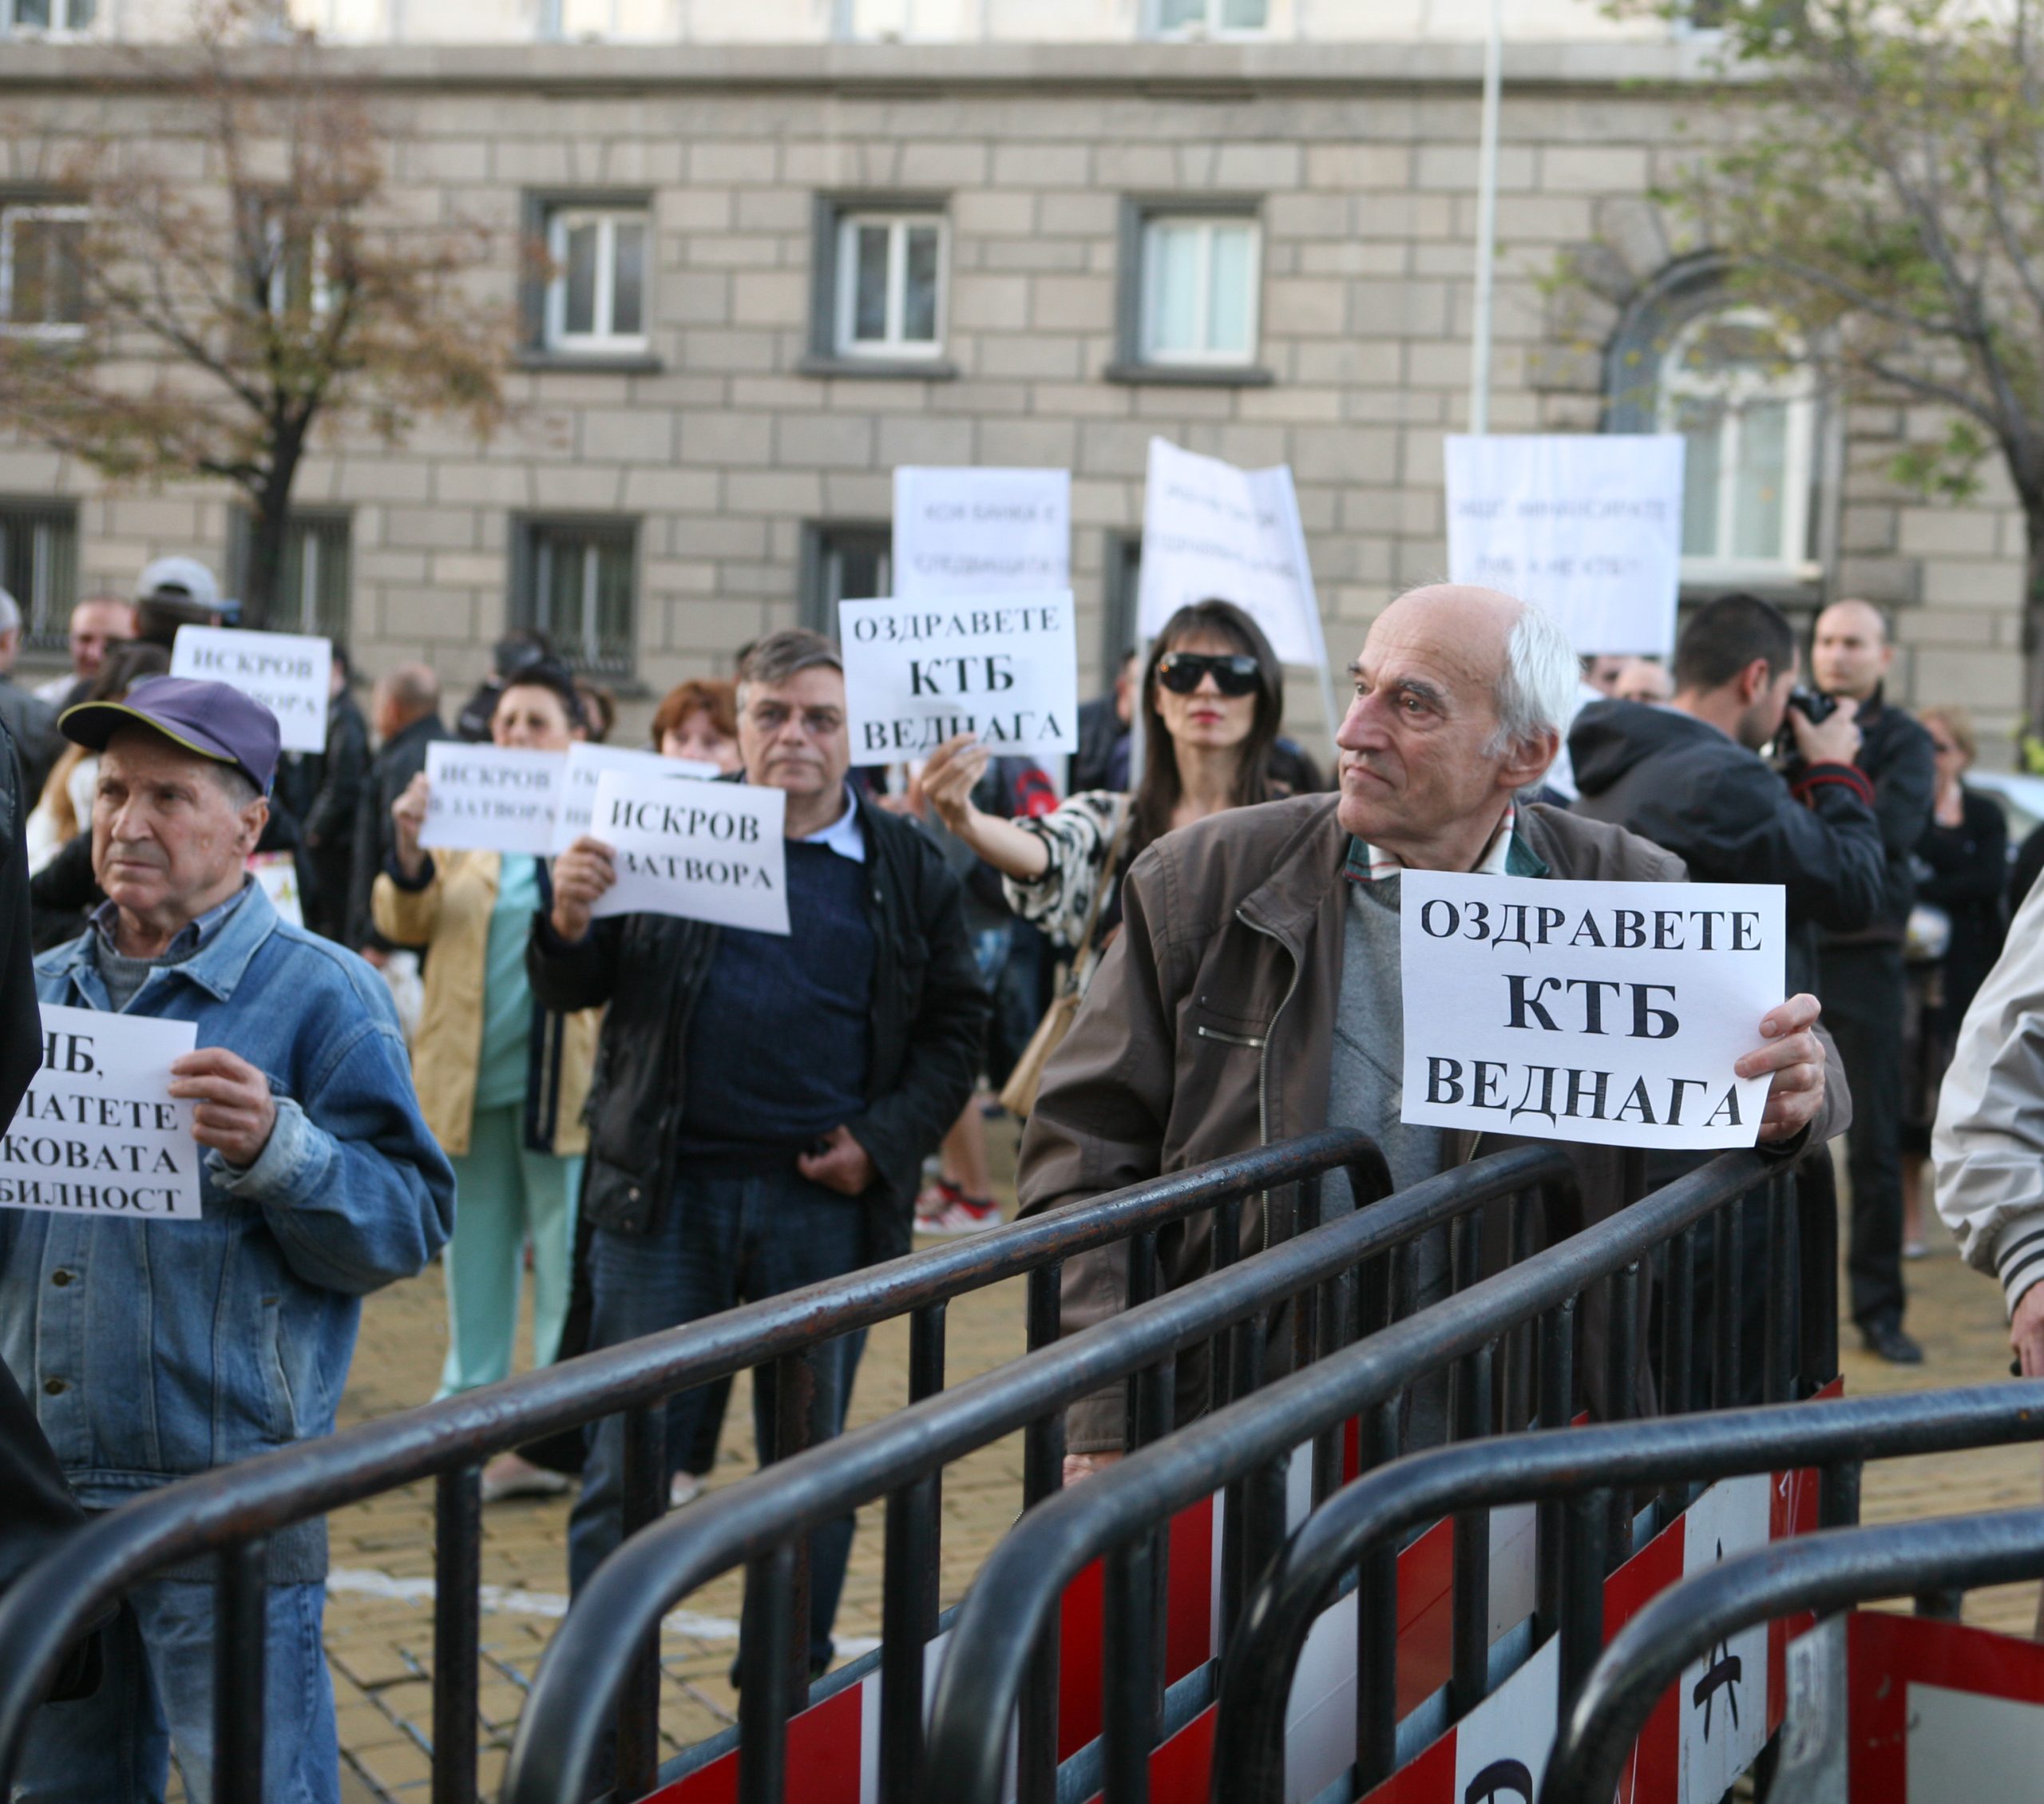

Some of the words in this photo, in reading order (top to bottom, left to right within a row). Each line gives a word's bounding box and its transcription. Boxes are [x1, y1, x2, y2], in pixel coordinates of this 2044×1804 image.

[854, 606, 1060, 644] ОЗДРАВЕТЕ
[193, 647, 312, 679] ИСКРОВ
[909, 653, 1015, 696] КТБ
[864, 710, 1063, 751] ВЕДНАГА
[440, 763, 551, 789] ИСКРОВ
[454, 799, 557, 824] ЗАТВОРА
[610, 799, 760, 843] ИСКРОВ
[623, 850, 773, 890] ЗАТВОРА
[1420, 899, 1763, 954] ОЗДРАВЕТЕ
[1500, 973, 1680, 1040] КТБ
[1424, 1056, 1745, 1129] ВЕДНАГА
